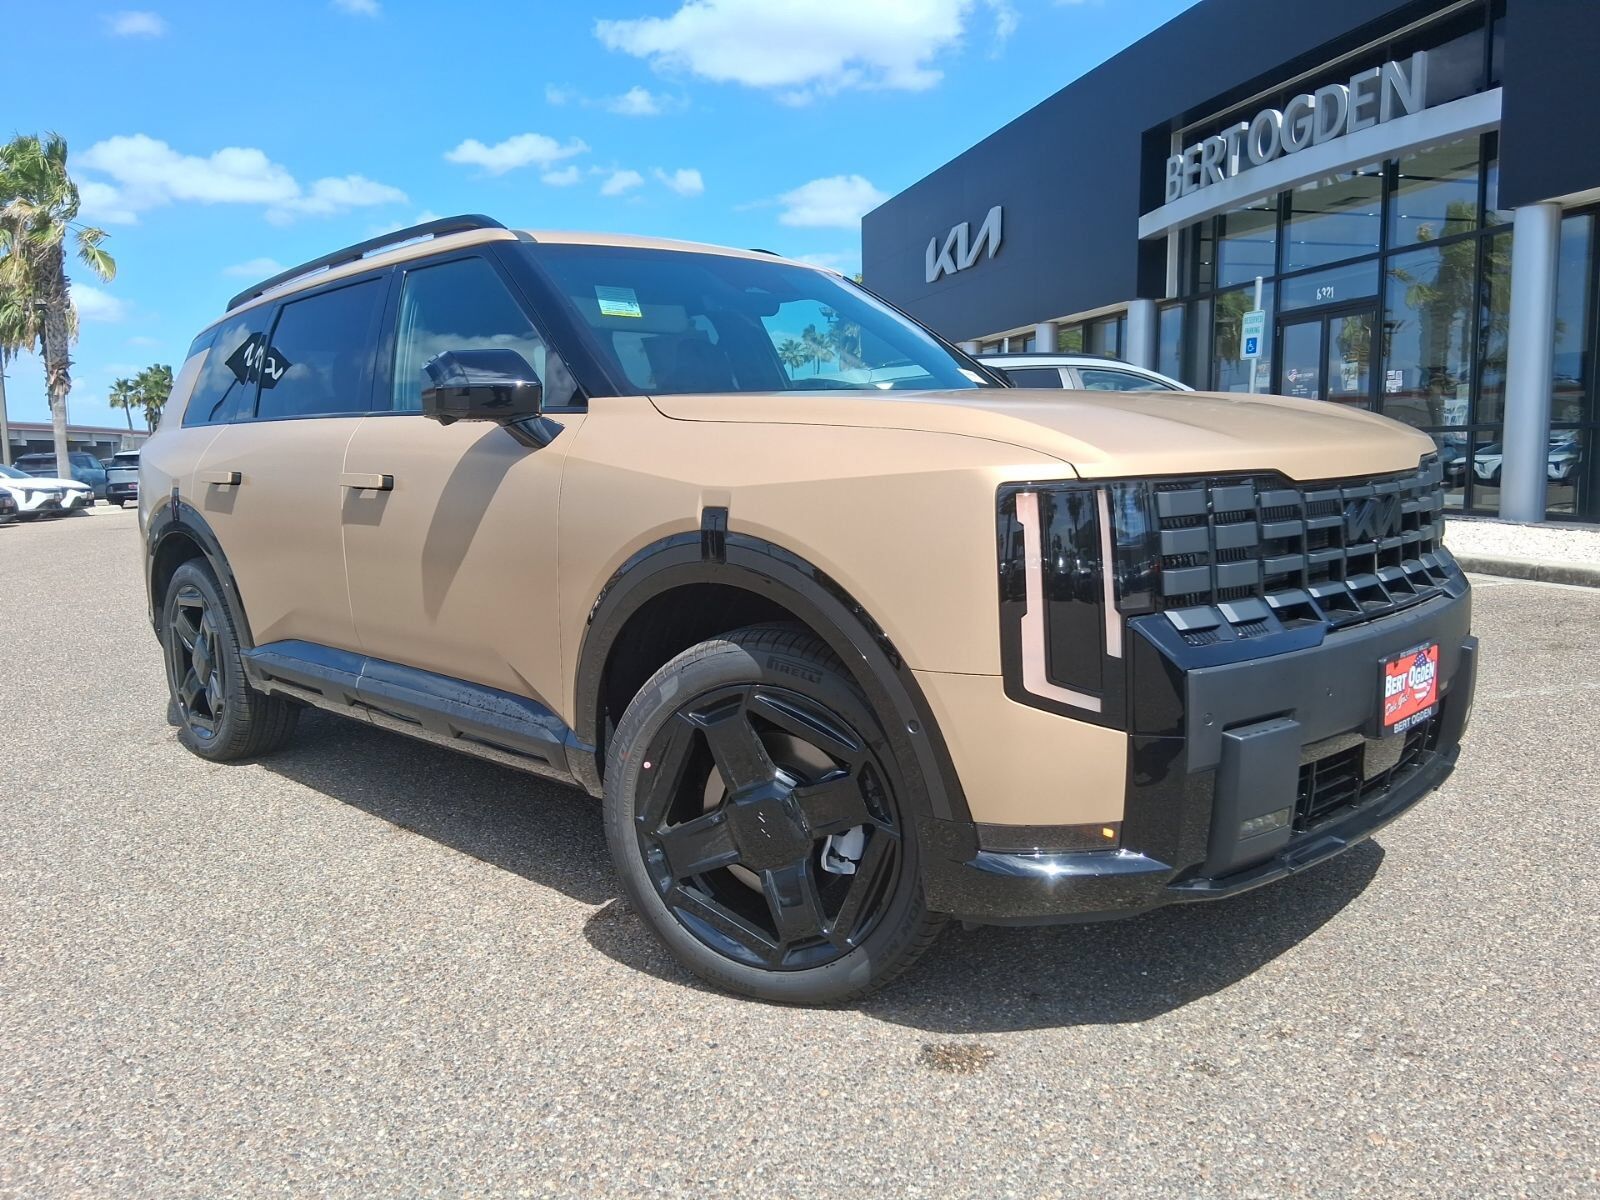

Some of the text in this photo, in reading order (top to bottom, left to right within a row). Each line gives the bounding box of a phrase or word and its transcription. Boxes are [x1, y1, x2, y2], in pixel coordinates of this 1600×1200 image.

[1165, 51, 1428, 205] BERT OGDEN
[925, 205, 1003, 283] KIA
[1344, 494, 1402, 541] KIA
[766, 655, 824, 685] PIRELLI
[1385, 661, 1435, 698] BERT OGDEN
[1393, 707, 1432, 734] BERT OGDEN
